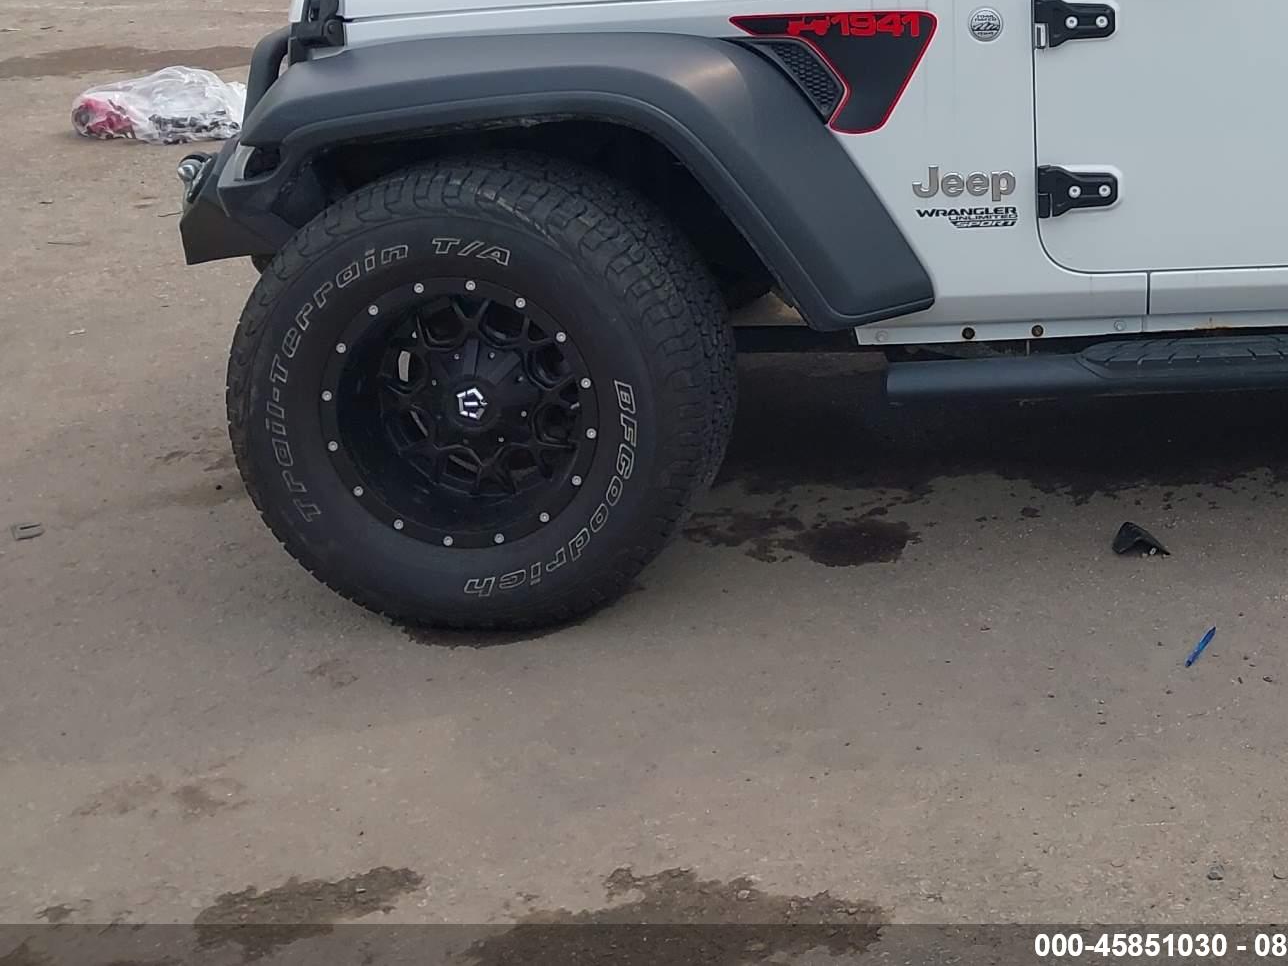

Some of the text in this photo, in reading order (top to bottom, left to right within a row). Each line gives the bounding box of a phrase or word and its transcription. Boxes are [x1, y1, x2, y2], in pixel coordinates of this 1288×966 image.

[831, 13, 920, 37] 1941
[912, 165, 1016, 202] Jeep
[916, 206, 1017, 218] WRANGLER
[953, 220, 1016, 228] SPORT
[265, 237, 511, 523] Trail-Terrain T/A
[463, 380, 640, 598] BFGoodrich
